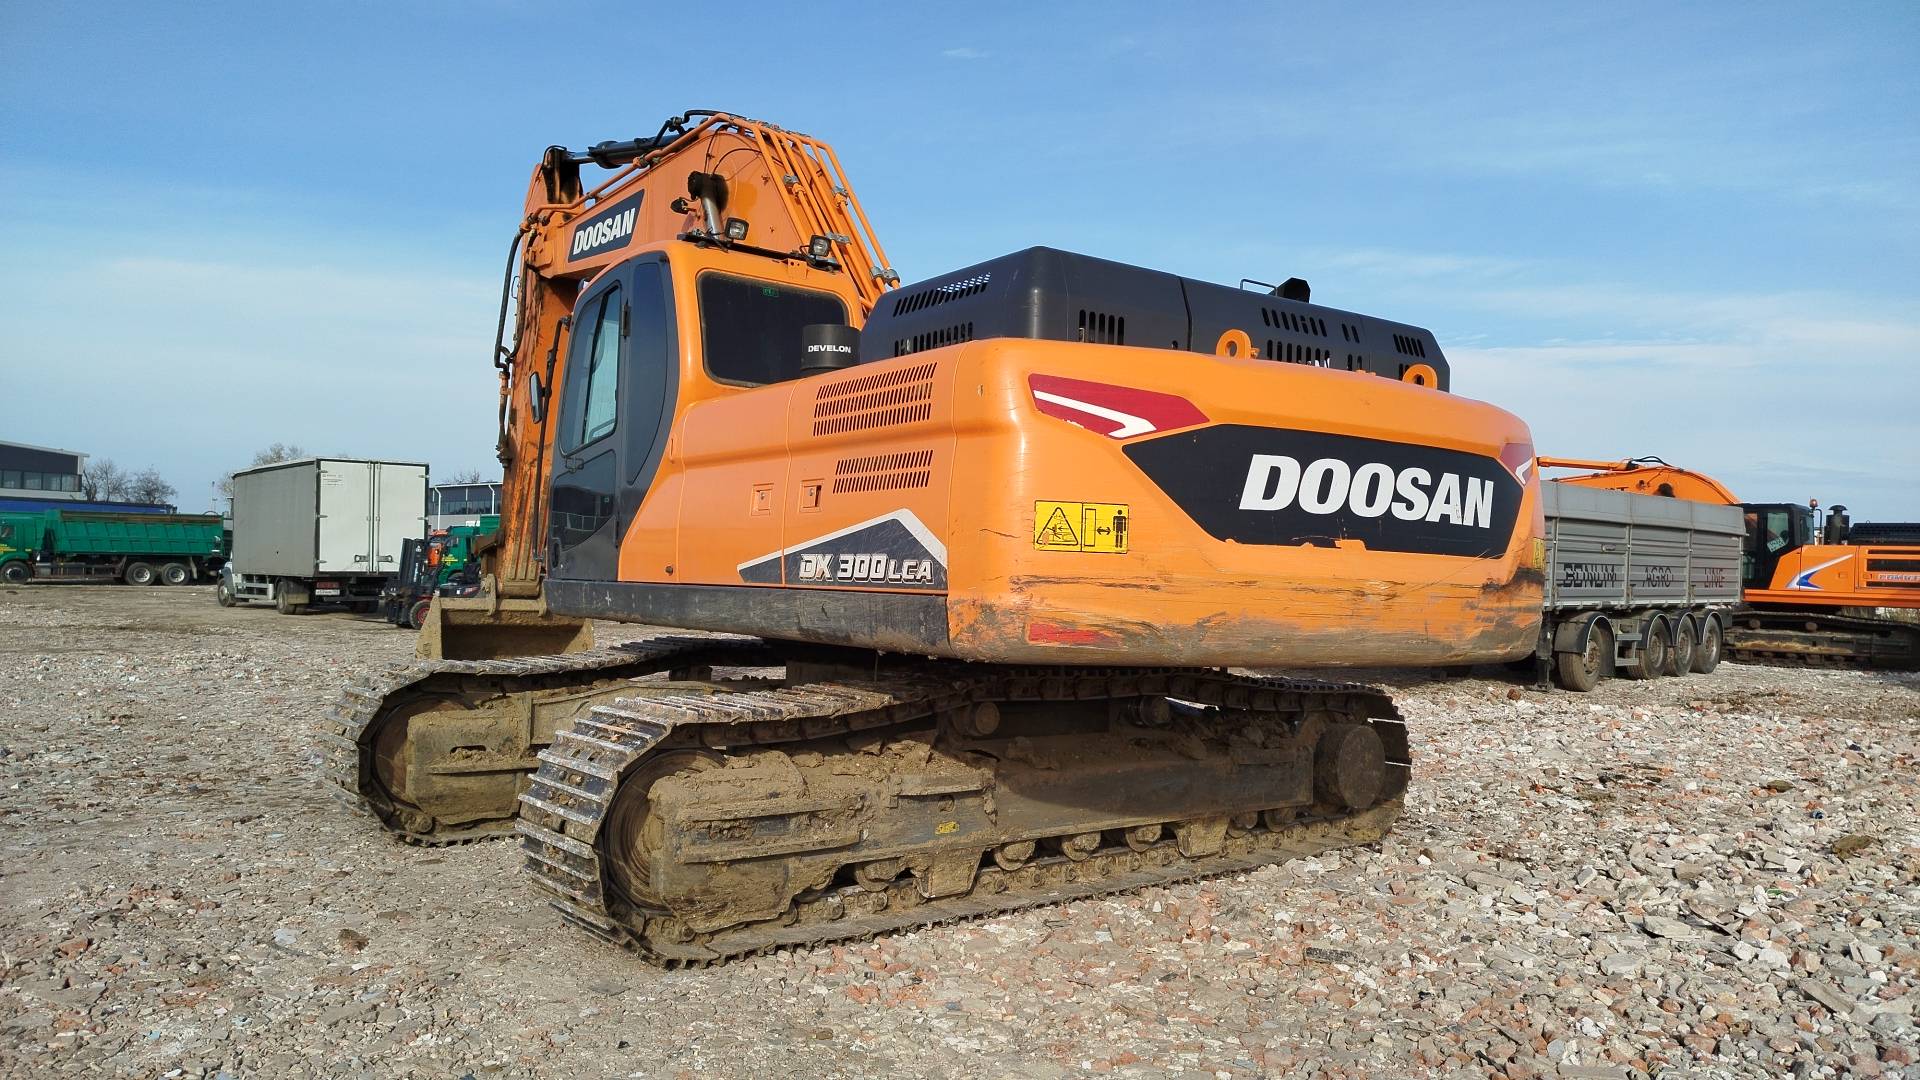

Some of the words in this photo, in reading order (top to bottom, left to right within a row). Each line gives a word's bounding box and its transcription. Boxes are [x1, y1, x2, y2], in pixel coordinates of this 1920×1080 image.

[572, 207, 636, 256] DOOSAN
[807, 344, 852, 354] DEVELON
[1239, 453, 1494, 528] DOOSAN
[799, 553, 834, 581] DX
[837, 553, 934, 584] 300LCA
[1563, 563, 1617, 588] BONUM
[1642, 566, 1674, 588] AGRO
[1703, 567, 1726, 588] LINE
